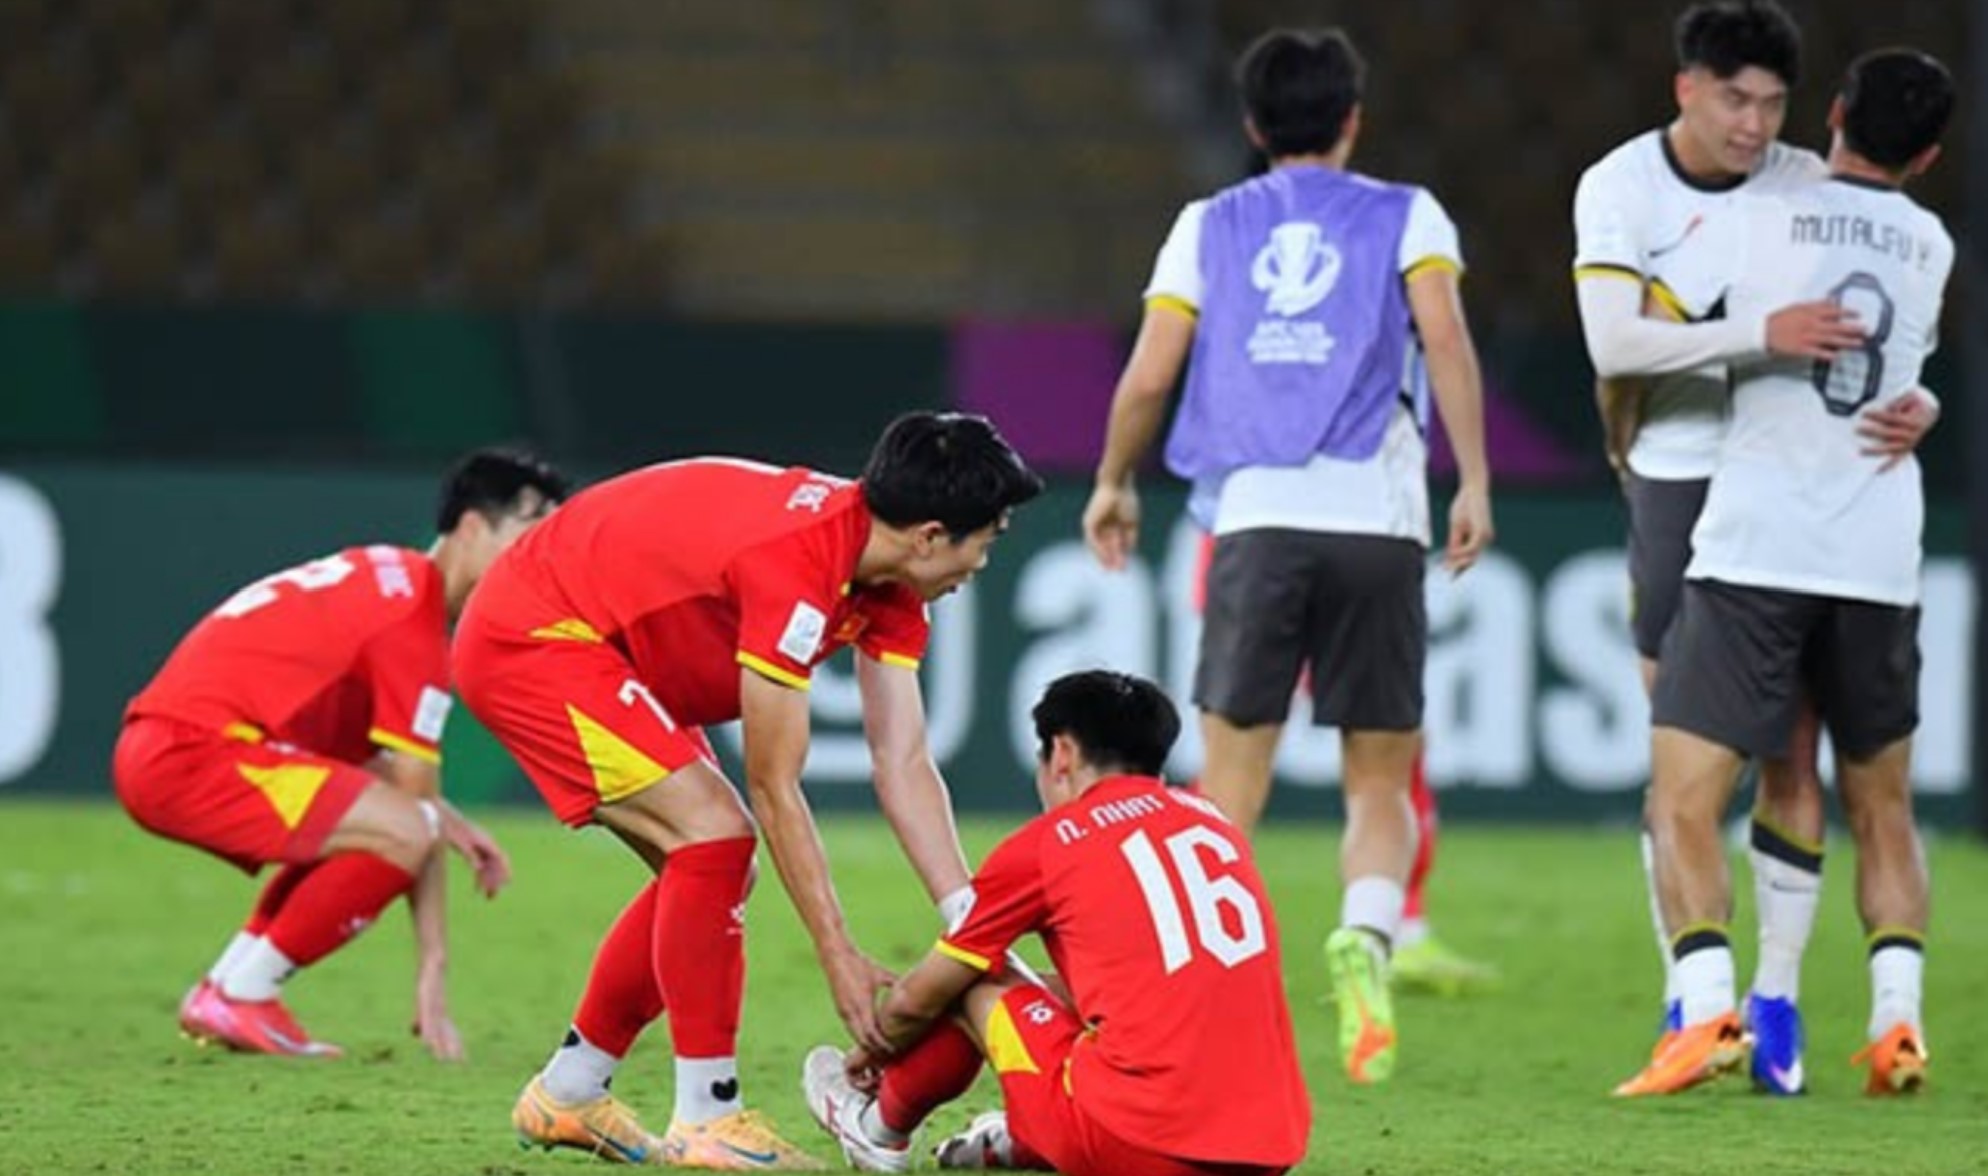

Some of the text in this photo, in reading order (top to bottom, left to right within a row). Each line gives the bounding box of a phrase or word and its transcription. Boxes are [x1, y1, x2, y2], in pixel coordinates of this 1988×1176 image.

[1813, 271, 1893, 417] 8
[617, 678, 676, 734] 7
[1119, 826, 1267, 975] 16
